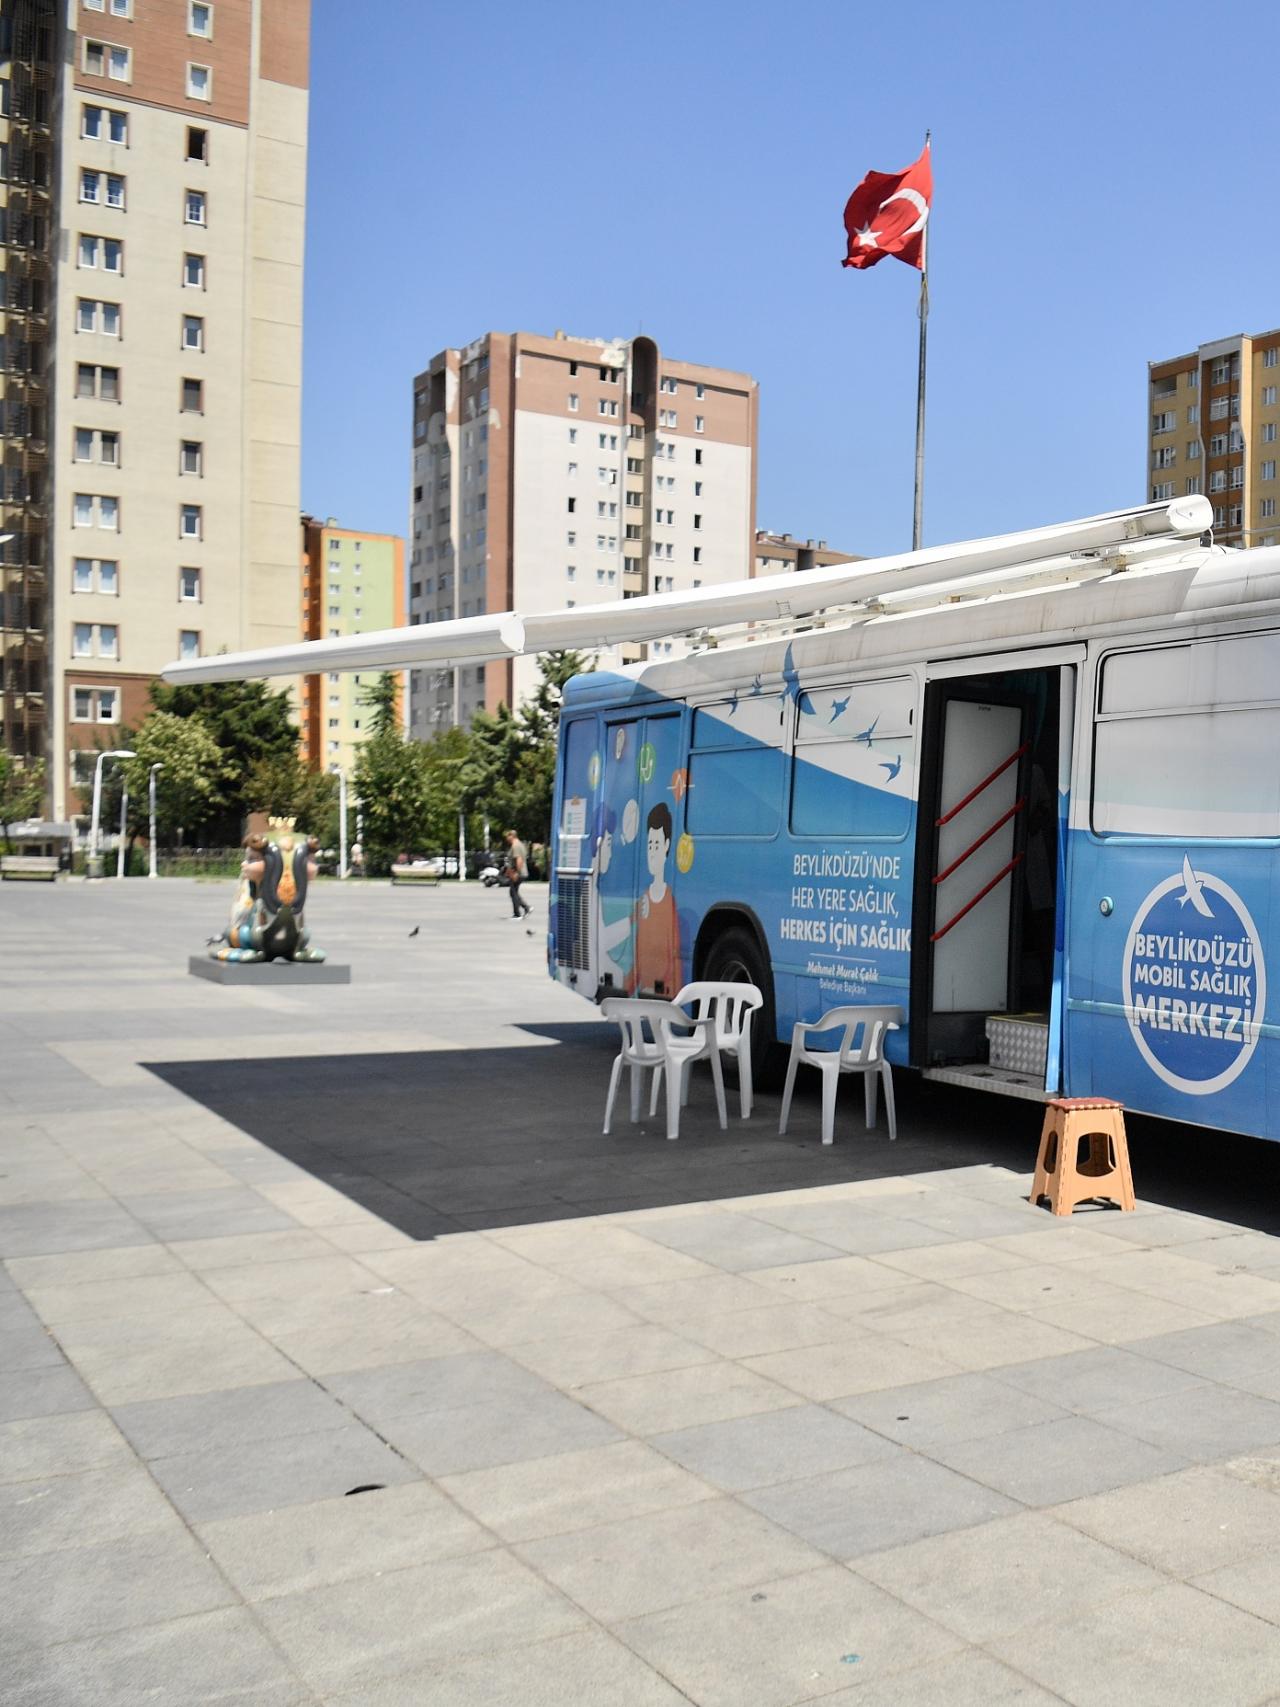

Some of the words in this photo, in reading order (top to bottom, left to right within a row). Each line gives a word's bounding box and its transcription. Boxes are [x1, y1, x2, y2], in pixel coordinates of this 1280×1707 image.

[793, 850, 901, 880] BEYLİKDÜZÜ'NDE
[791, 887, 814, 909] HER
[817, 888, 846, 912] YERE
[849, 885, 899, 919] SAĞLIK,
[780, 918, 826, 945] HERKES
[829, 916, 857, 952] İÇİN
[860, 920, 912, 952] SAĞLIK
[1135, 931, 1254, 970] BEYLİKDÜZÜ
[1134, 962, 1187, 990] MOBİL
[1190, 966, 1252, 998] SAĞLIK
[1133, 993, 1252, 1045] MERKEZİ
